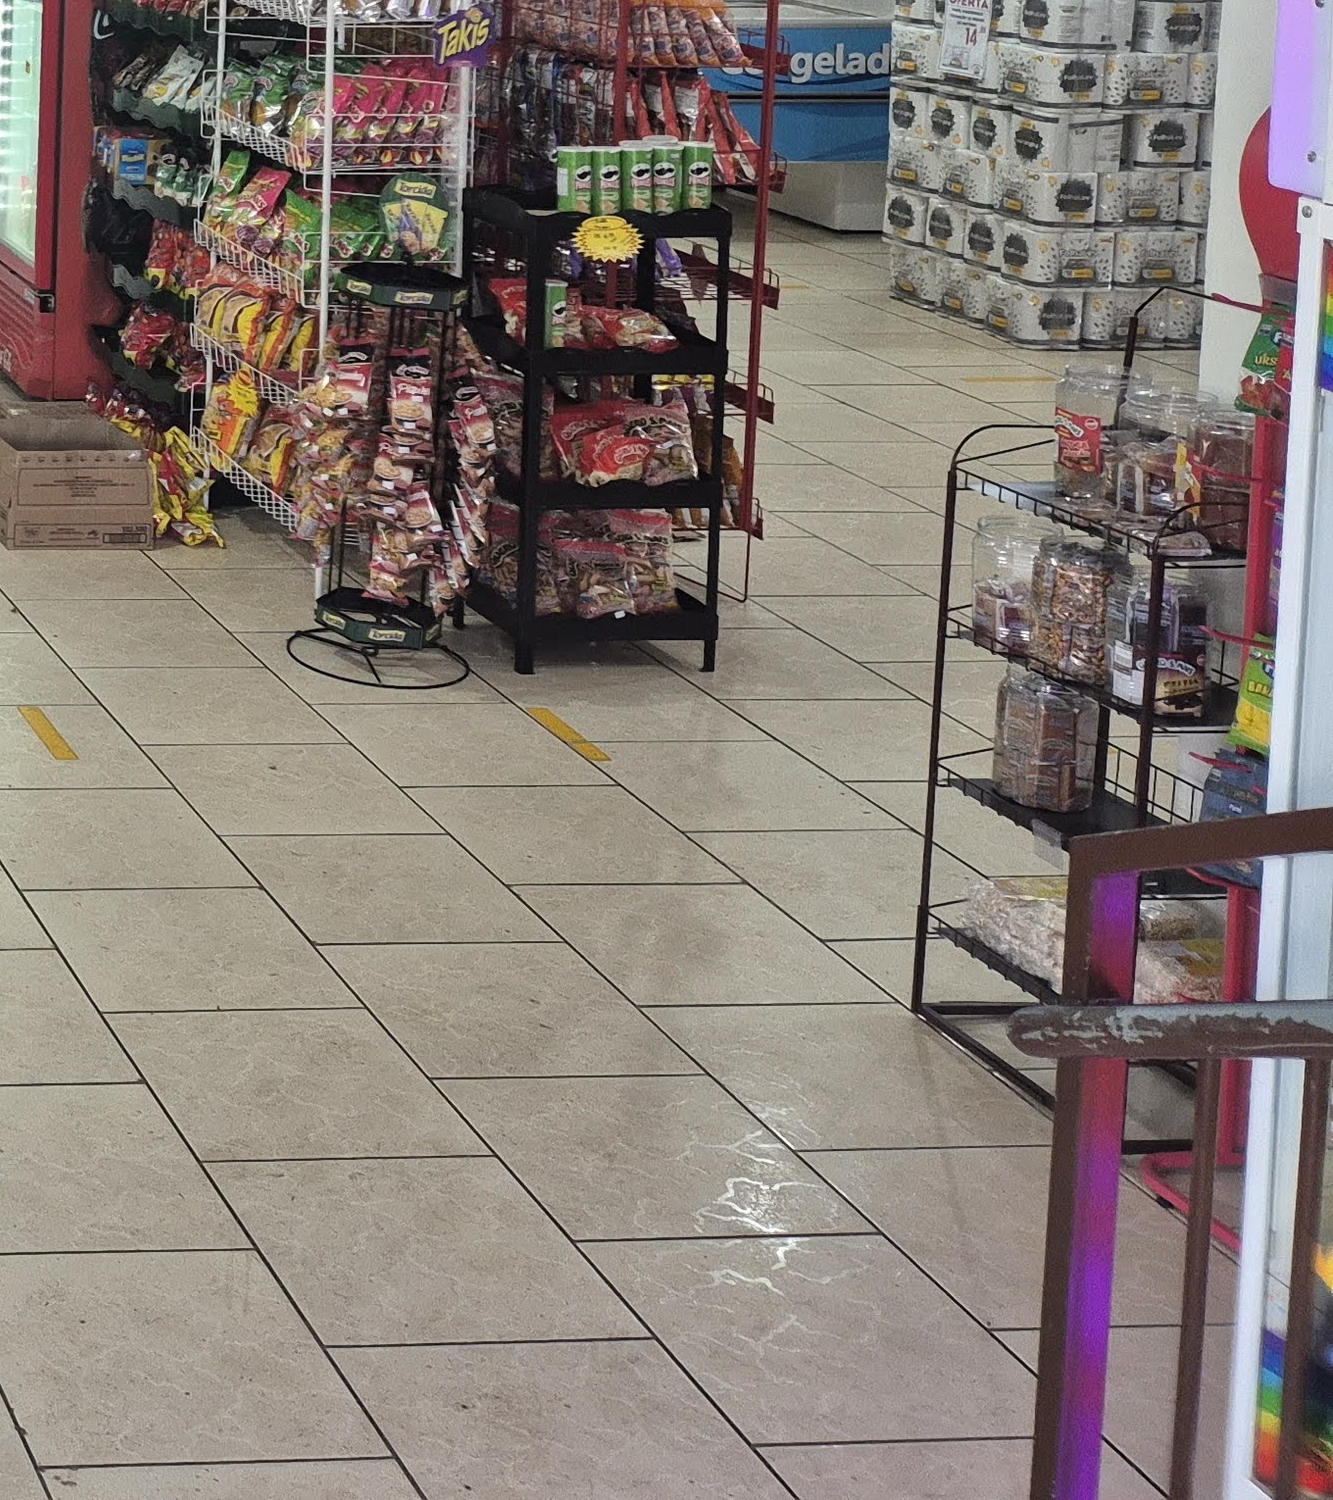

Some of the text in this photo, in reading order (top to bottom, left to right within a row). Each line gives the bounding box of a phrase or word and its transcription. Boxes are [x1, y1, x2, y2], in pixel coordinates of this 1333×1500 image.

[437, 18, 491, 65] Takis
[790, 42, 890, 84] gelad
[399, 182, 433, 196] Torcida
[1254, 354, 1279, 367] URS
